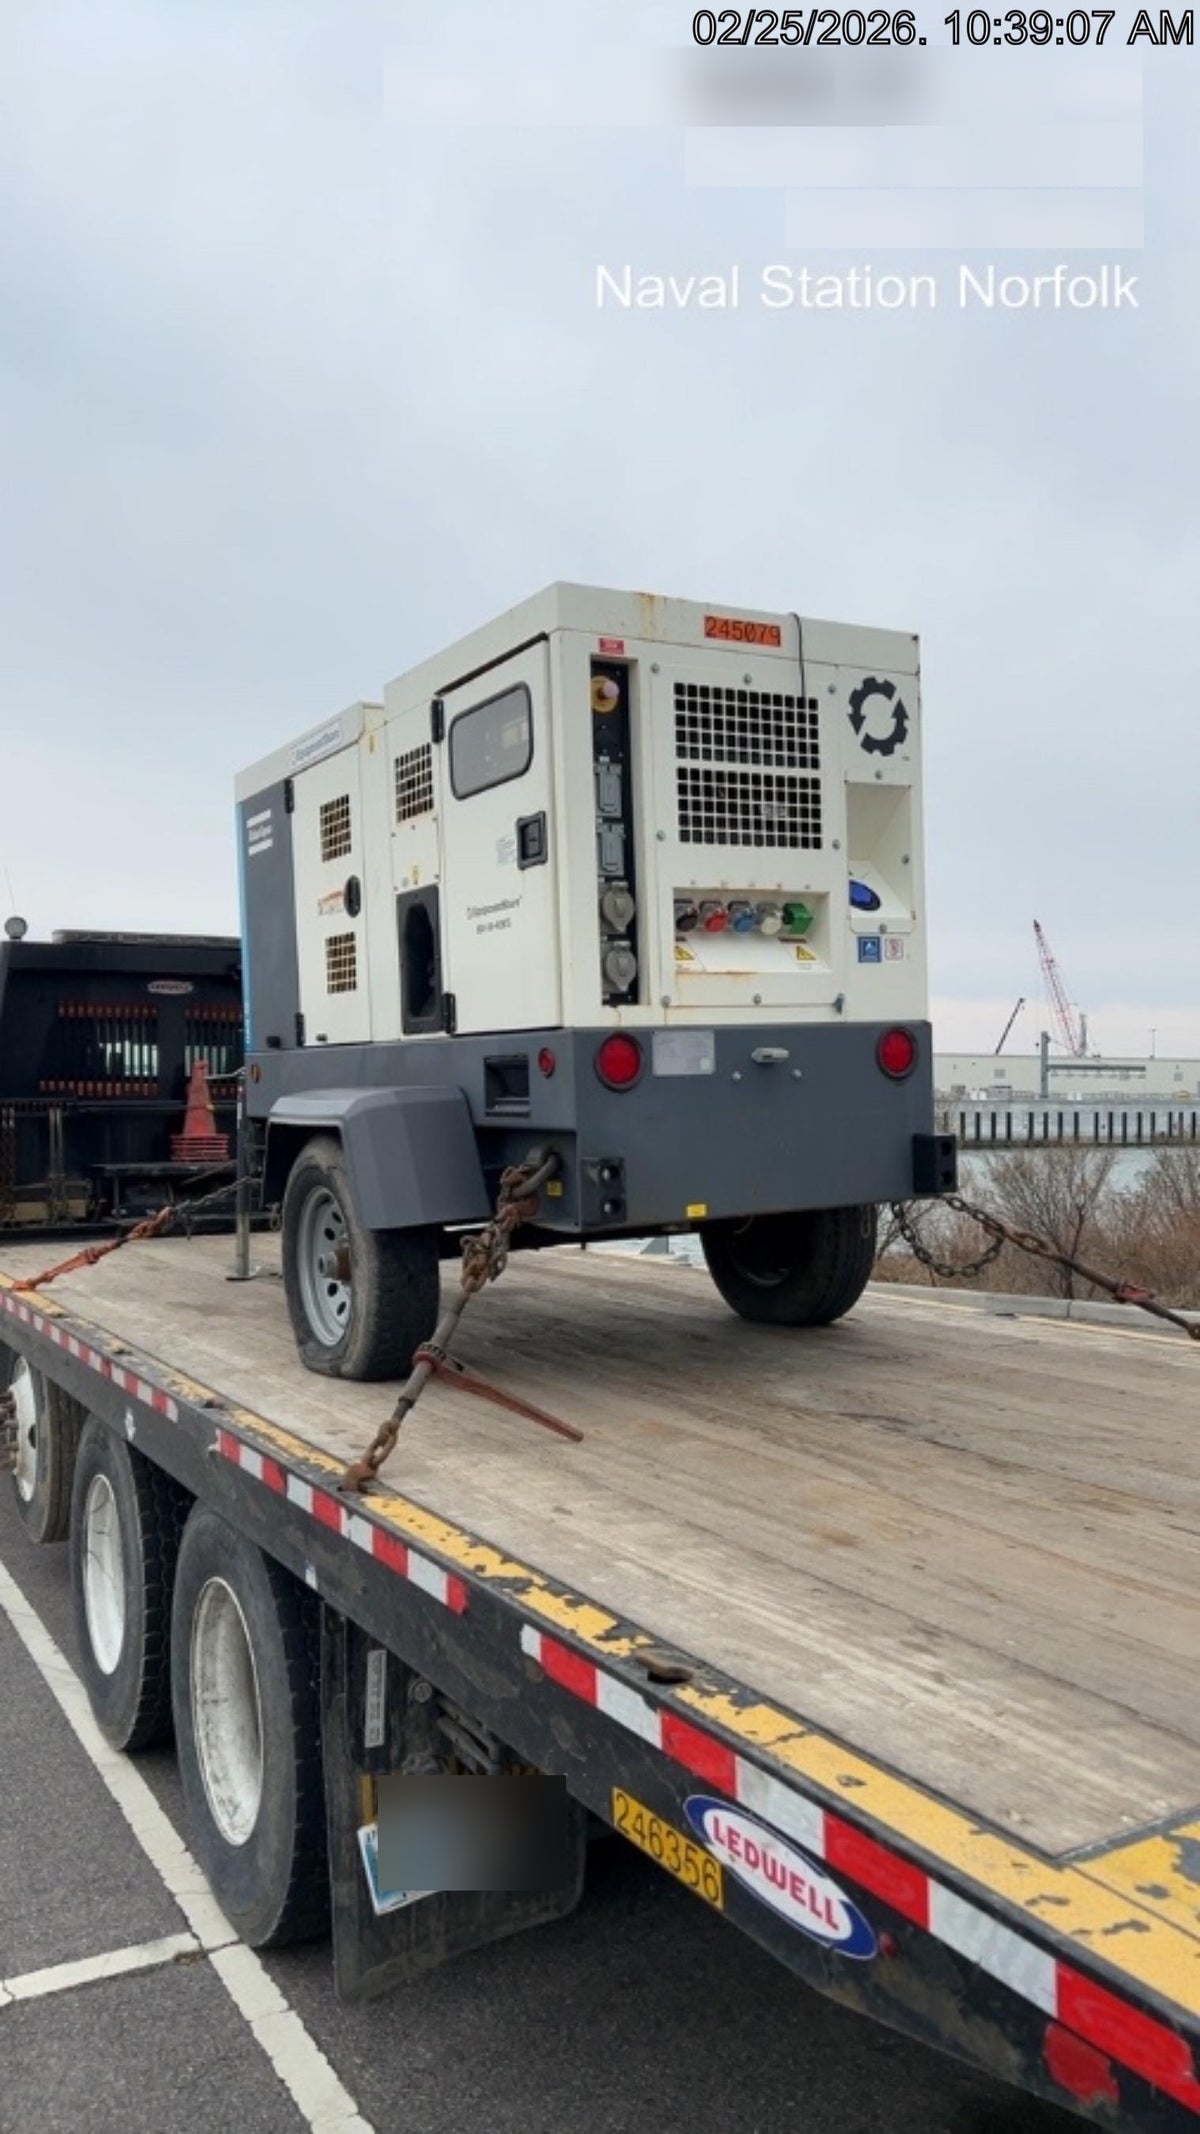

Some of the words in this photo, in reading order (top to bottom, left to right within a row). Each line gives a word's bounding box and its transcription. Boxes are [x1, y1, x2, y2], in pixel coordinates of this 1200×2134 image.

[704, 615, 782, 647] 245079
[616, 1791, 721, 1904] 246356
[712, 1815, 840, 1932] LEDWELL
